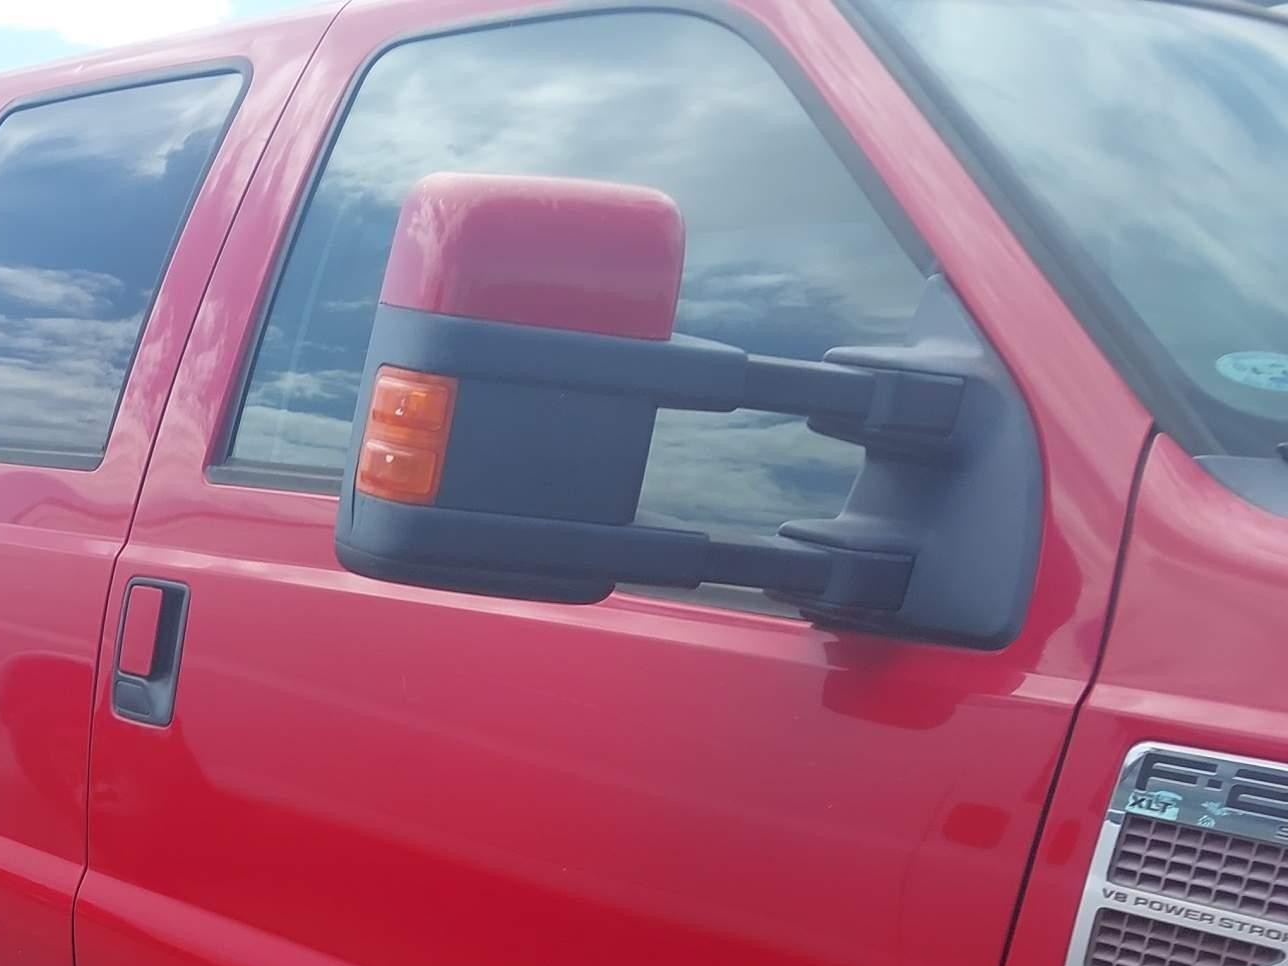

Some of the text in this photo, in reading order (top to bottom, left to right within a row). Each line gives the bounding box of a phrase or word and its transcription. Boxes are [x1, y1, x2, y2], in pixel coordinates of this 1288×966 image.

[1128, 795, 1173, 813] XLT
[1102, 887, 1128, 903] V8
[1133, 896, 1215, 925] POWER
